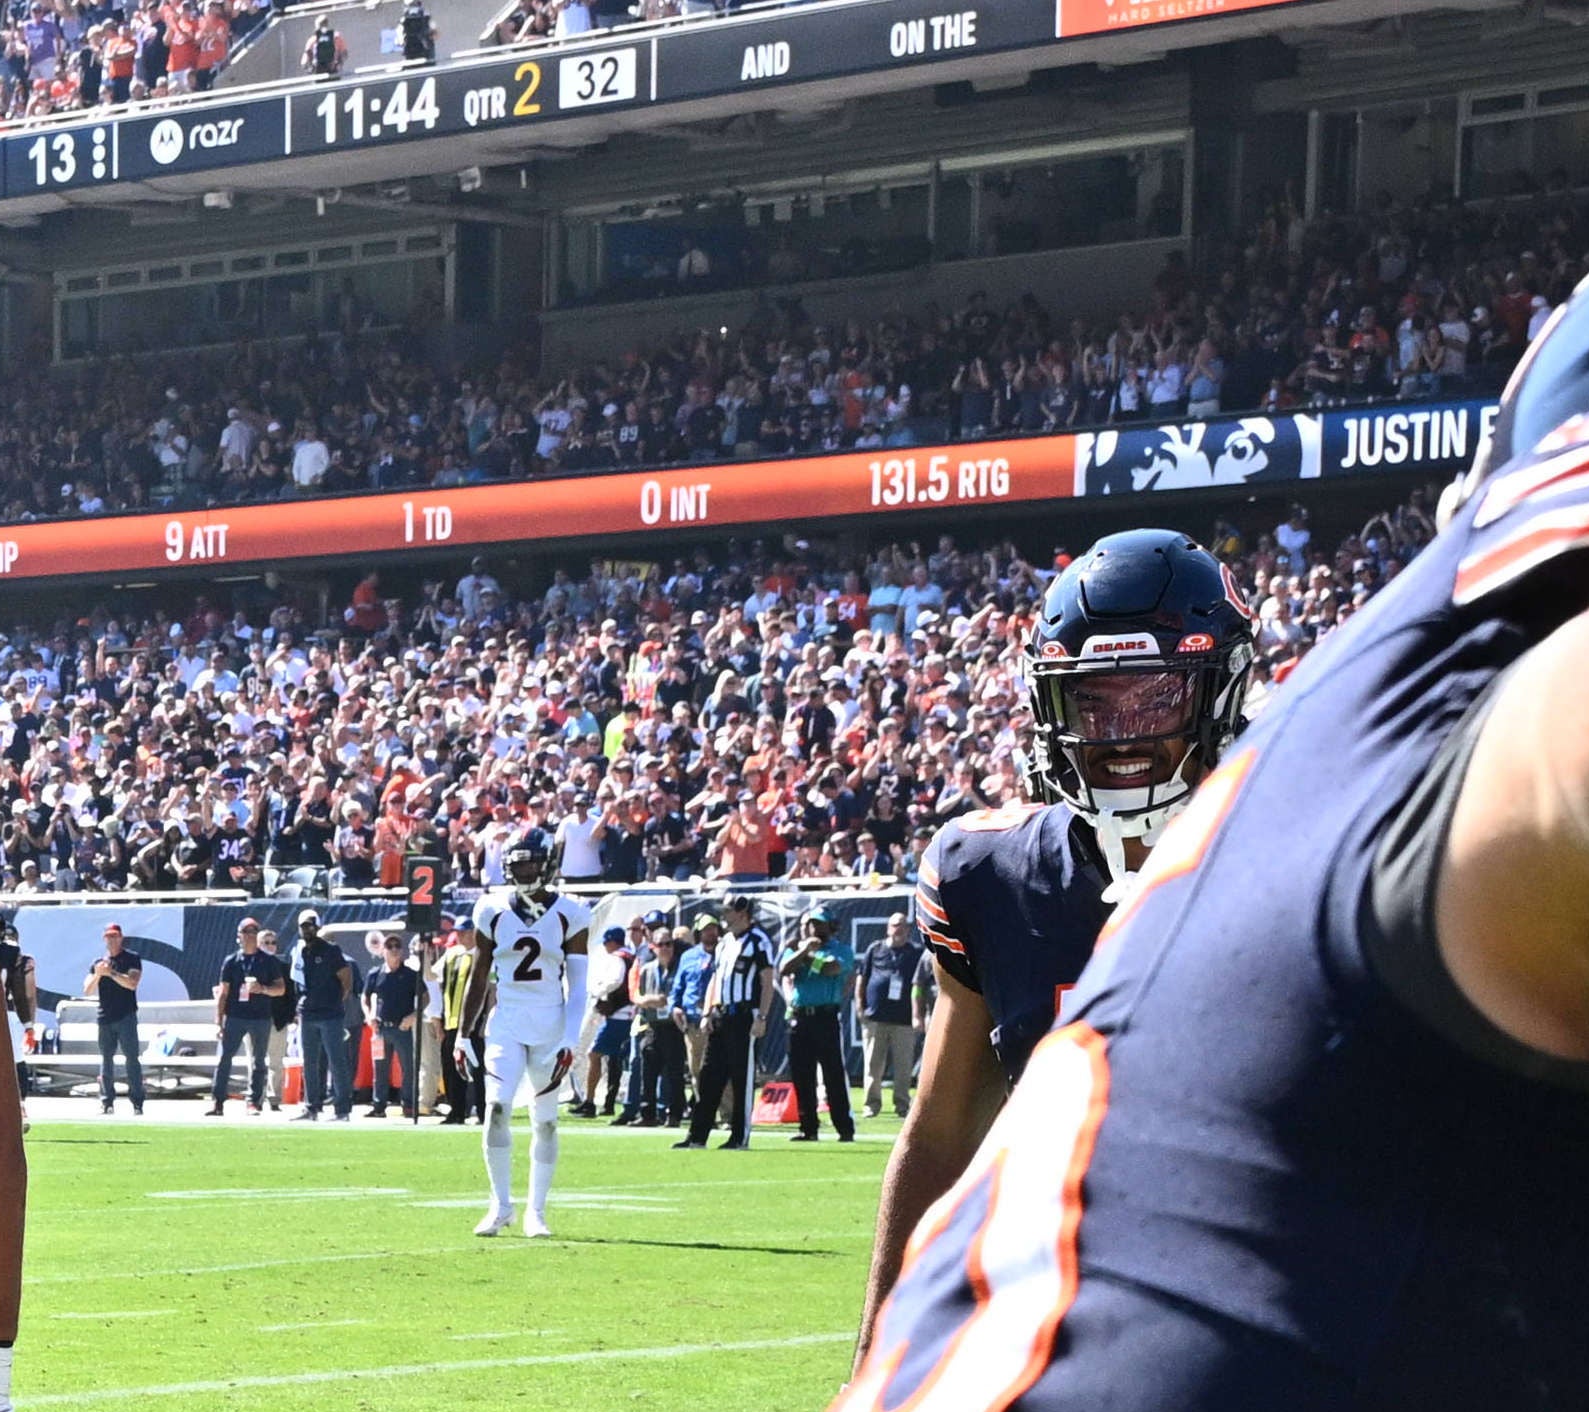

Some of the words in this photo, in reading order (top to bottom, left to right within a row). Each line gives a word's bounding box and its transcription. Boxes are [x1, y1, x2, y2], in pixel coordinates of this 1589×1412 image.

[890, 22, 925, 57] ON
[930, 12, 976, 50] THE
[1108, 4, 1151, 25] HARD
[576, 56, 619, 100] 32
[740, 42, 790, 81] AND
[316, 77, 439, 143] 11:44
[464, 87, 506, 126] QTR
[513, 62, 542, 116] 2
[189, 118, 243, 149] razr
[28, 133, 76, 185] 13
[1341, 408, 1468, 468] JUSTIN
[640, 480, 662, 524] 0
[669, 485, 711, 521] INT
[869, 456, 949, 506] 131.5
[958, 458, 1010, 498] RTG
[165, 520, 184, 562] 9
[190, 524, 229, 559] ATT
[402, 502, 415, 542] 1
[422, 506, 452, 540] TD
[1093, 640, 1148, 653] BEARS
[219, 839, 239, 859] 34
[411, 865, 434, 905] 2
[512, 936, 543, 982] 2
